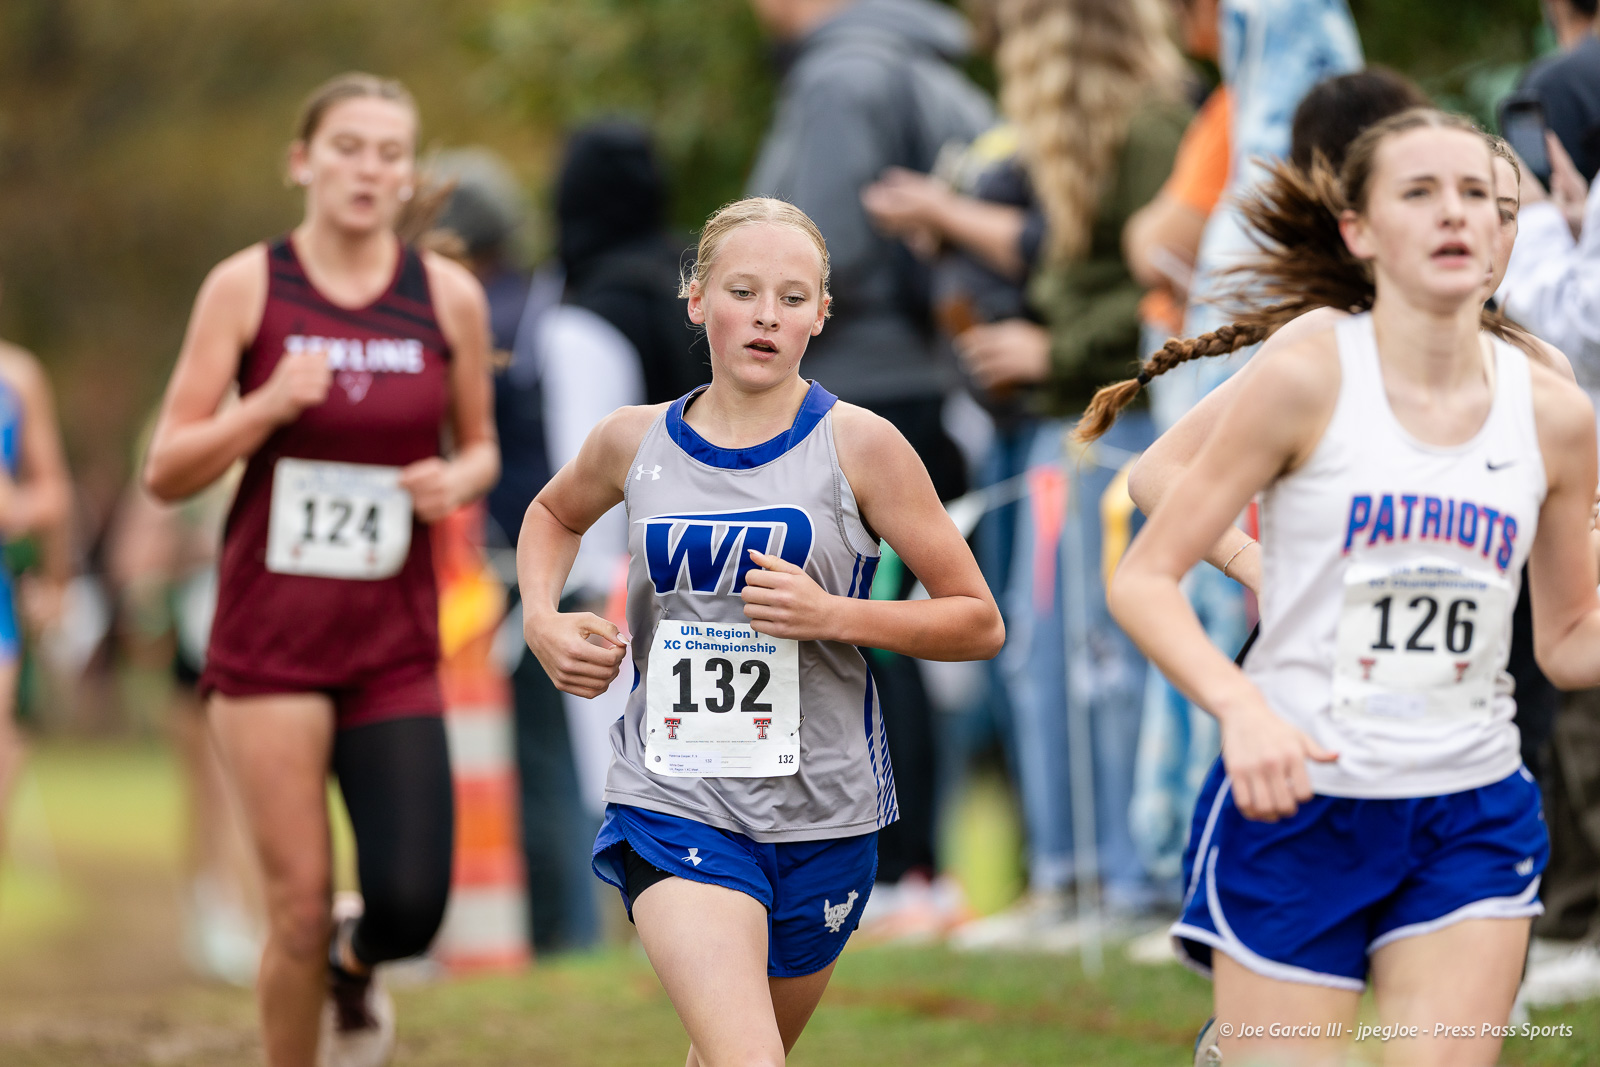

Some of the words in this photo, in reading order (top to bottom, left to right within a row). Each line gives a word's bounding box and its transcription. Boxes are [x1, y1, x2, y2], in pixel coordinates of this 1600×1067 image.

[301, 496, 380, 547] 124
[1341, 493, 1517, 573] PATRIOTS
[663, 640, 681, 650] XC
[685, 640, 777, 655] Championship
[681, 626, 703, 636] UIL
[706, 627, 750, 639] Region
[1371, 594, 1477, 654] 126
[672, 657, 773, 714] 132
[778, 755, 794, 764] 132
